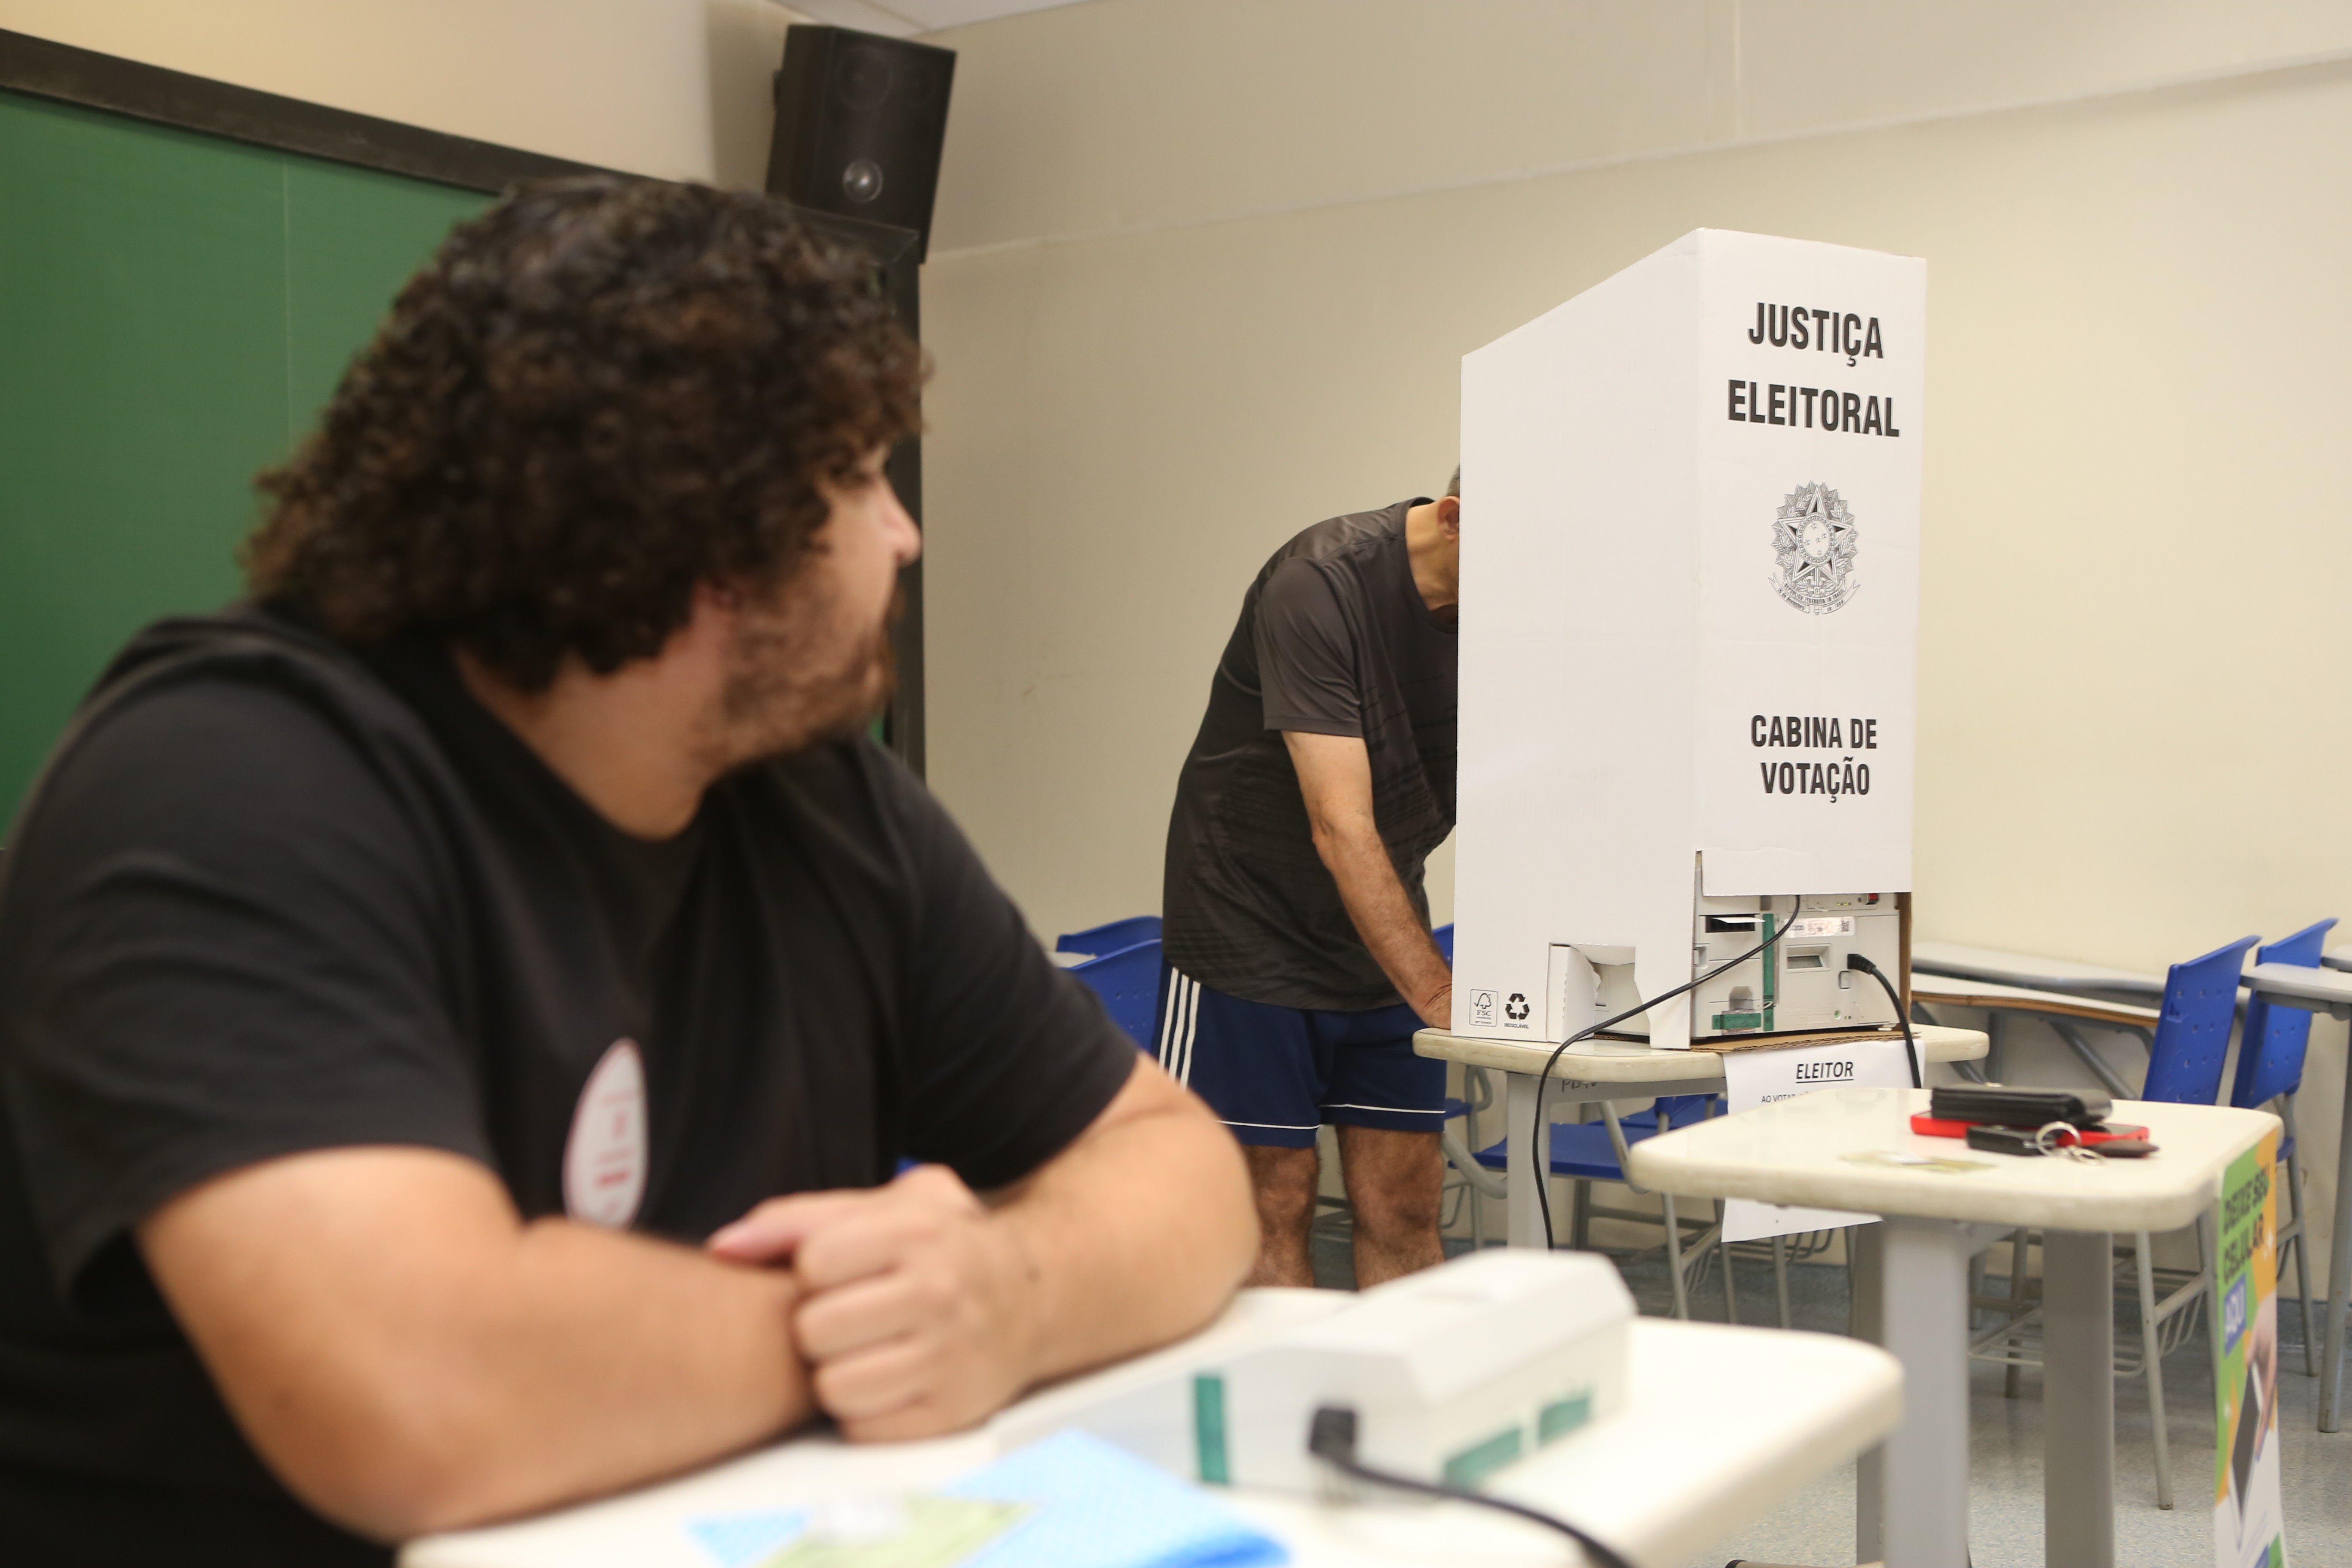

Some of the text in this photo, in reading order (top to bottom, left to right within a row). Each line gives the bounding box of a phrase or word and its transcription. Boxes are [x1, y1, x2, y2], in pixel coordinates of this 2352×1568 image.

[1747, 302, 1884, 367] JUSTIÇA
[1727, 379, 1900, 437] ELEITORAL
[1751, 715, 1877, 749] CABINA DE
[1761, 756, 1870, 803] VOTAÇÃO
[1796, 1062, 1853, 1079] ELEITOR
